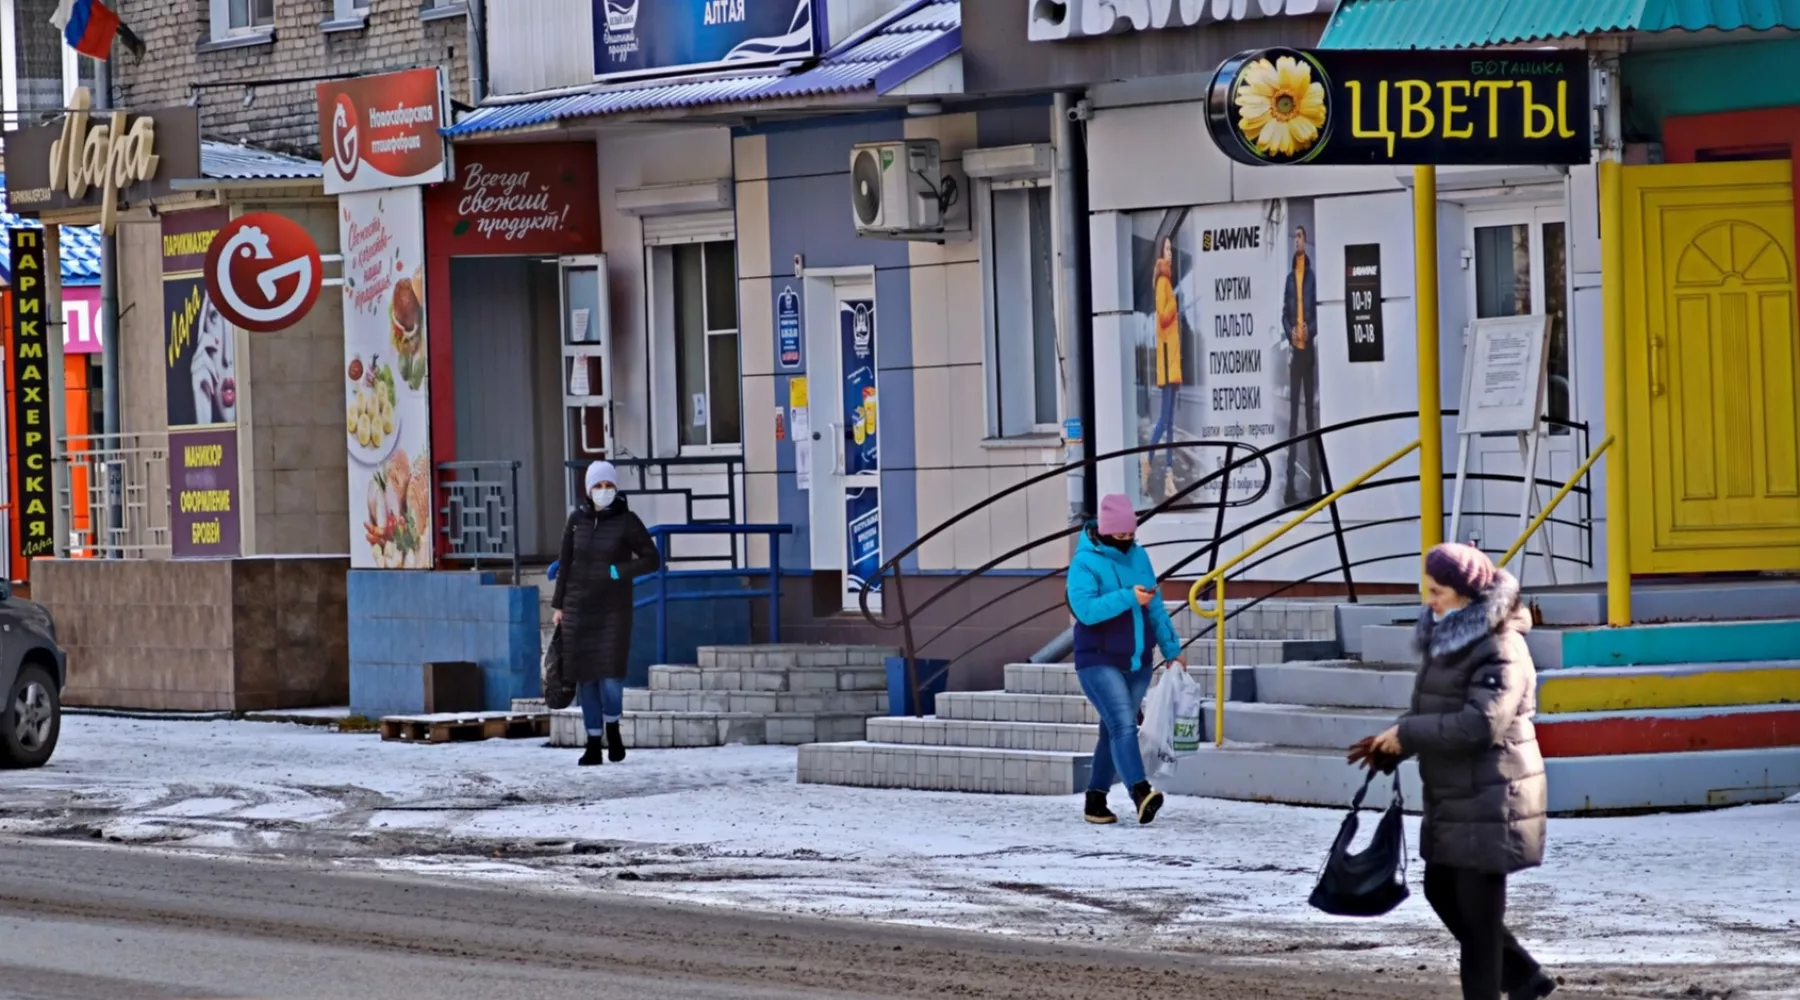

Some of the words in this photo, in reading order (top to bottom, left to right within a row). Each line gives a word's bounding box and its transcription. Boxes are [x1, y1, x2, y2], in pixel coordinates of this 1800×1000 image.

[704, 0, 745, 25] АЛТАЯ
[1471, 60, 1565, 75] БОТАНИКА
[369, 101, 433, 128] Новосибирская
[1344, 79, 1576, 158] ЦВЕТЫ
[50, 87, 160, 236] Лара
[463, 162, 530, 195] Всегда
[458, 184, 550, 216] свежий
[477, 203, 570, 240] продукт!
[1213, 226, 1261, 251] LAWINE
[1352, 265, 1378, 276] LAWINE
[1215, 276, 1251, 302] КУРТКИ
[1352, 290, 1373, 311] 10-19
[168, 284, 200, 368] Лара
[1215, 312, 1254, 338] ПАЛЬТО
[1353, 323, 1375, 343] 10-18
[1209, 349, 1261, 375] ПУХОВИКИ
[17, 231, 46, 537] ПАРИКМАХЕРСКАЯ
[1212, 385, 1261, 412] ВЕТРОВКИ
[184, 444, 223, 468] МАНИКЮР
[180, 489, 230, 513] ОФОРМЛЕНИЕ
[192, 517, 221, 544] БРОВЕЙ
[22, 536, 53, 556] Лара
